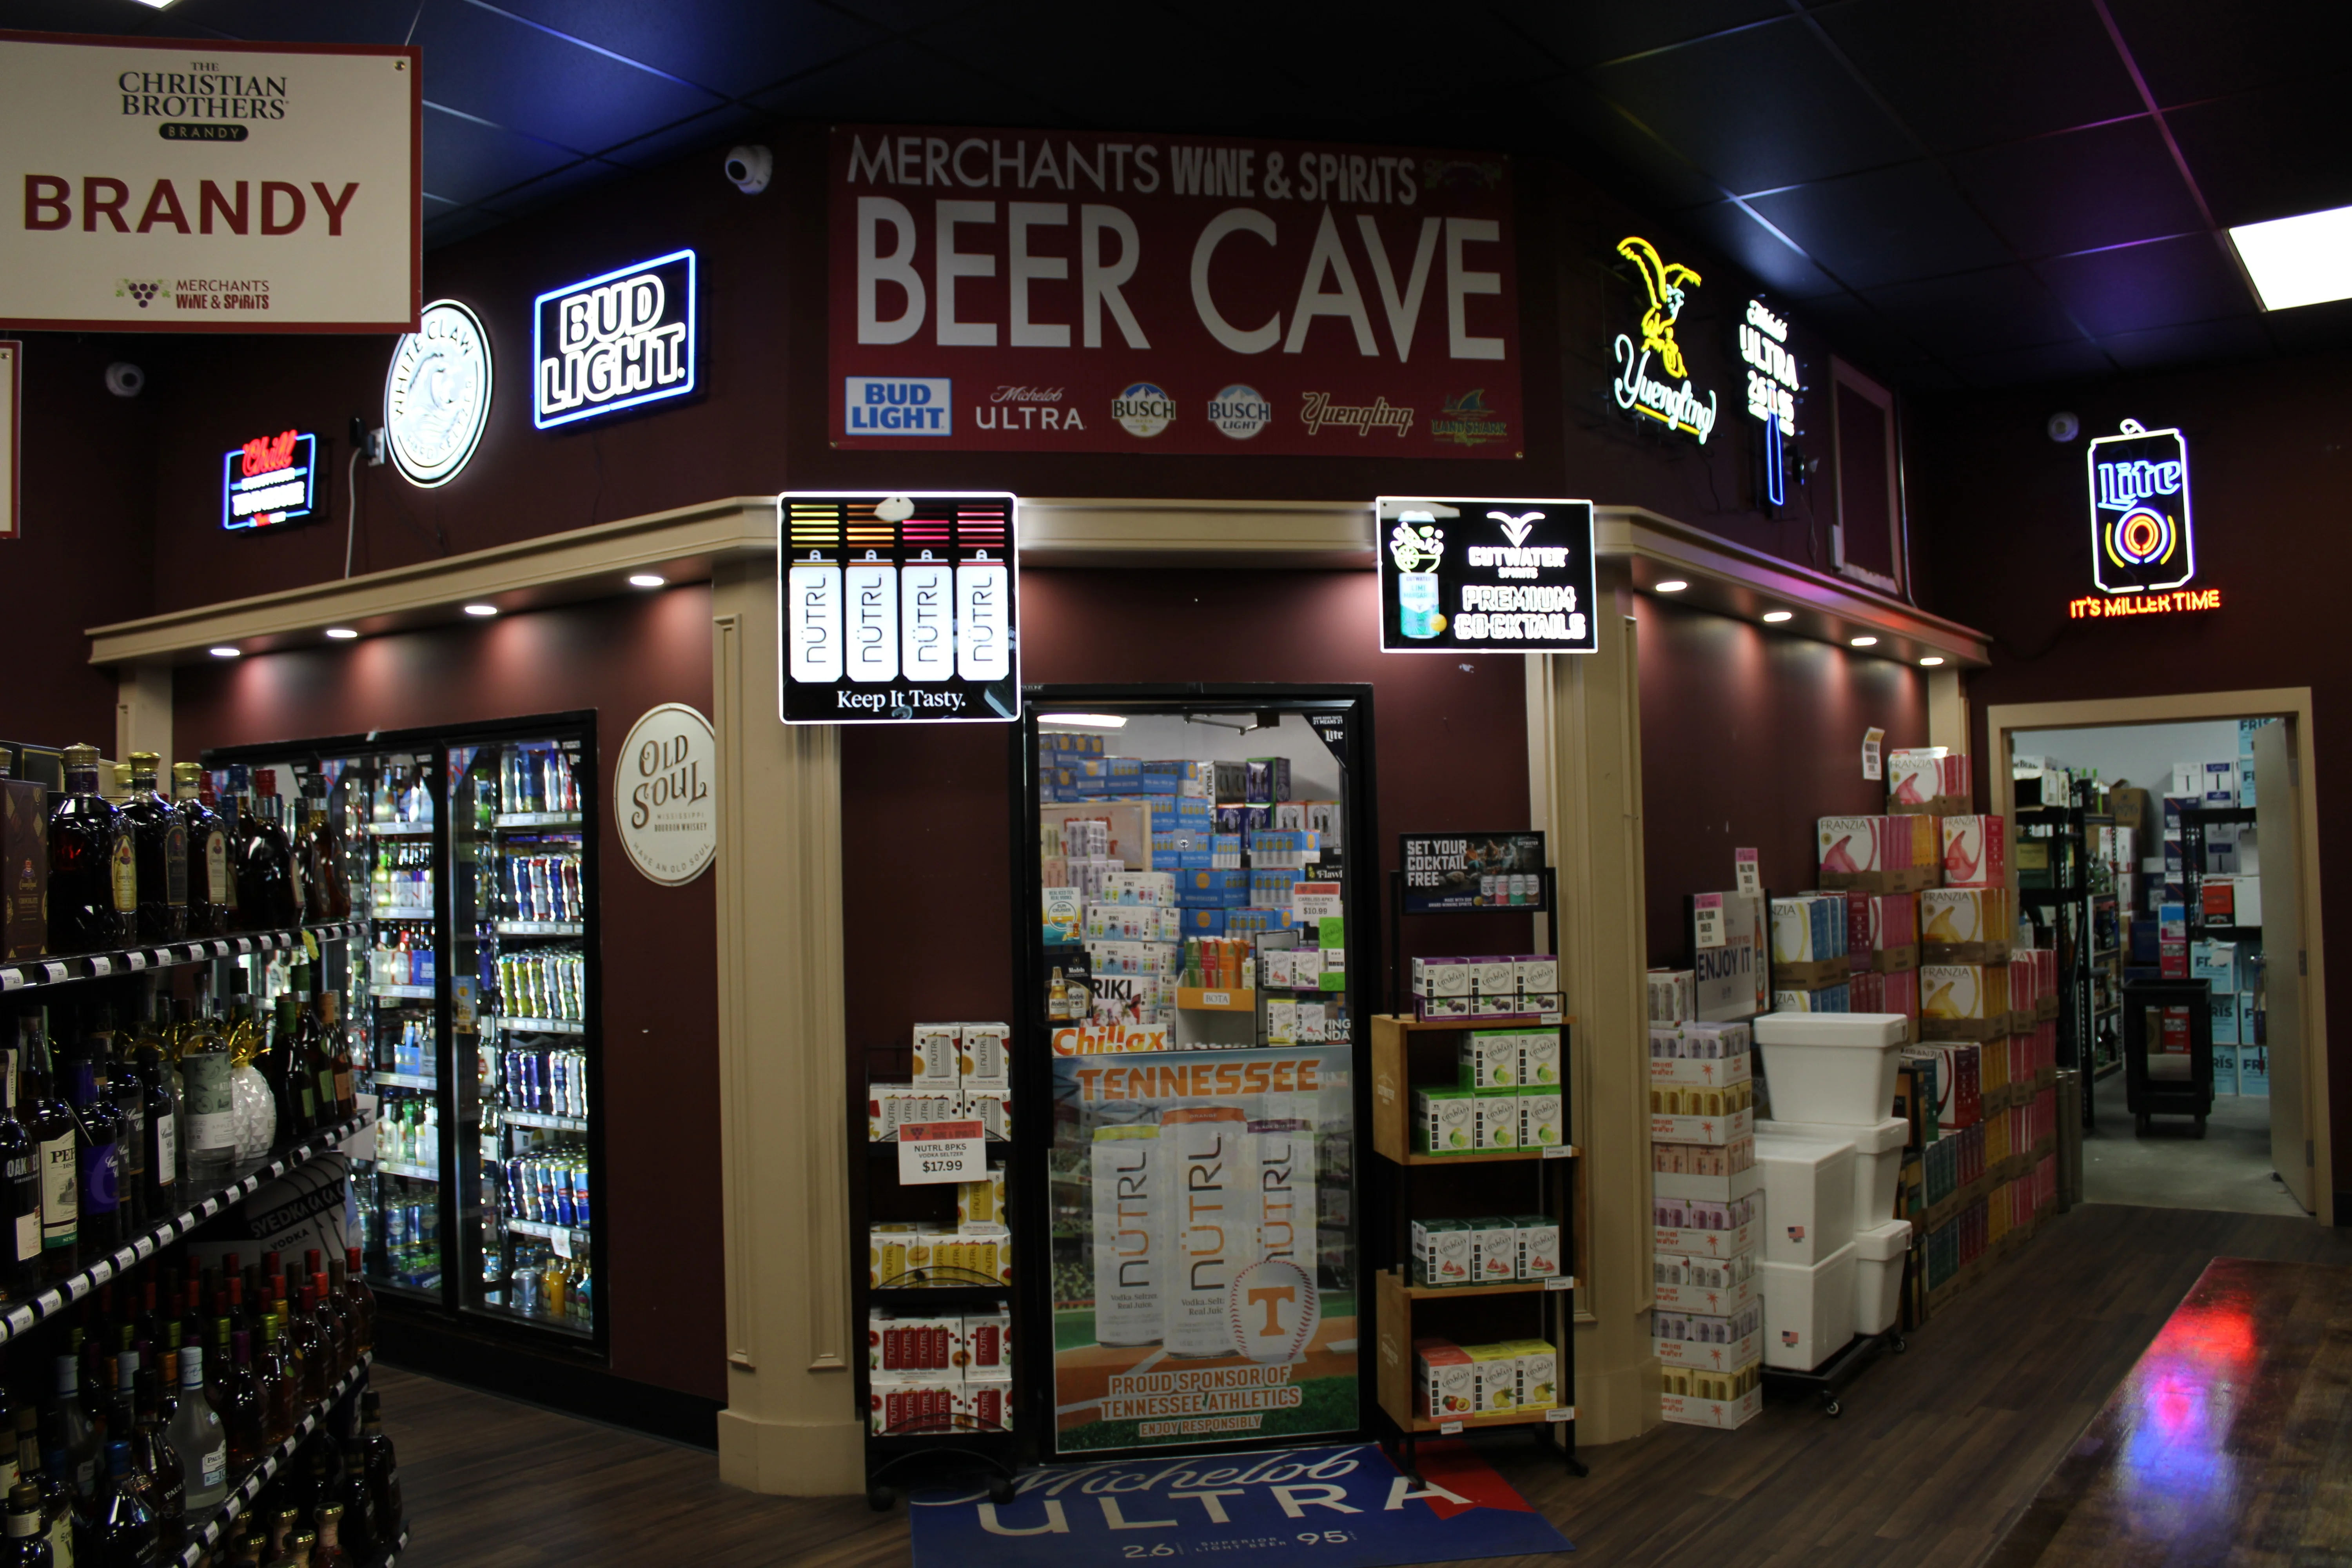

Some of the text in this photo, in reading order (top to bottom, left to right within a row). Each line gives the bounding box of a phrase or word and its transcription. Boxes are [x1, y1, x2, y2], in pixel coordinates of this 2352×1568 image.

[191, 62, 219, 72] THE
[118, 71, 287, 98] CHRISTIAN
[121, 95, 286, 120] BROTHERS
[168, 126, 240, 139] BRANDY
[847, 134, 1417, 205] MERCHANTS WINE & SPIRITS
[24, 174, 360, 236] BRANDY
[176, 279, 270, 292] MERCHANTS
[857, 196, 1506, 363] BEER CAVE
[176, 294, 270, 310] WINE & SPIRITS
[559, 274, 666, 356] BUD
[428, 319, 474, 356] CLAW
[1739, 324, 1800, 392] ULTRA
[394, 333, 424, 422] WHITE
[865, 383, 931, 405] BUD
[990, 385, 1065, 403] Michelob
[1614, 334, 1717, 445] Yuengling
[852, 406, 945, 429] LIGHT
[976, 407, 1085, 430] ULTRA
[1114, 399, 1176, 419] BUSCH
[1209, 401, 1271, 421] BUSCH
[1301, 392, 1414, 437] Yuengling
[1223, 421, 1258, 430] LIGHT
[242, 429, 298, 477] Chill
[2097, 460, 2182, 512] Lite
[1468, 546, 1568, 568] CUTWATER
[1461, 585, 1577, 613] PREMIUM
[2070, 589, 2221, 619] IT'S MILLER TIME
[1453, 613, 1586, 640] COCKTAILS
[837, 690, 966, 712] Keep It Tasty.
[1325, 730, 1343, 742] Lite
[638, 734, 688, 778] OLD
[1890, 759, 1933, 770] FRANZIA
[631, 760, 708, 829] SOUL
[654, 822, 708, 832] BOURBON WHISKEY
[1821, 819, 1867, 832] FRANZIA
[1945, 816, 1977, 827] FRANZIA
[633, 842, 710, 873] HAVE AN OLD SOUL
[1407, 840, 1468, 855] SET YOUR
[1407, 855, 1468, 871] COCKTAIL
[1408, 872, 1439, 886] FREE
[1923, 891, 1970, 902] FRANZIA
[1303, 907, 1328, 915] $10.99
[1697, 946, 1751, 982] ENJOY IT
[1923, 967, 1970, 978] FRANZIA
[1091, 978, 1133, 1001] RIKI
[1437, 971, 1466, 987] carbliss
[1482, 970, 1510, 987] carbliss
[1205, 995, 1228, 1004] BOTA
[1075, 1059, 1321, 1101] TENNESSEE
[945, 1143, 967, 1151] 8PKS
[922, 1160, 963, 1173] $17.99
[270, 1229, 310, 1251] VODKA
[1189, 1308, 1206, 1316] Real
[1248, 1286, 1296, 1337] T
[1111, 1366, 1289, 1396] PROUD SPONSOR OF
[1102, 1387, 1300, 1419] TENNESSEE ATHLETICS
[1140, 1416, 1261, 1436] ENJOY RESPONSIBLY
[207, 1454, 221, 1464] PAUL
[910, 1447, 1366, 1506] Michelob
[163, 1483, 182, 1501] PAUL
[977, 1476, 1474, 1536] ULTRA
[1122, 1543, 1175, 1559] 2.6
[1296, 1531, 1349, 1545] 95
[1195, 1541, 1287, 1552] LIGHT BEER
[1200, 1537, 1278, 1548] SUPERIOR
